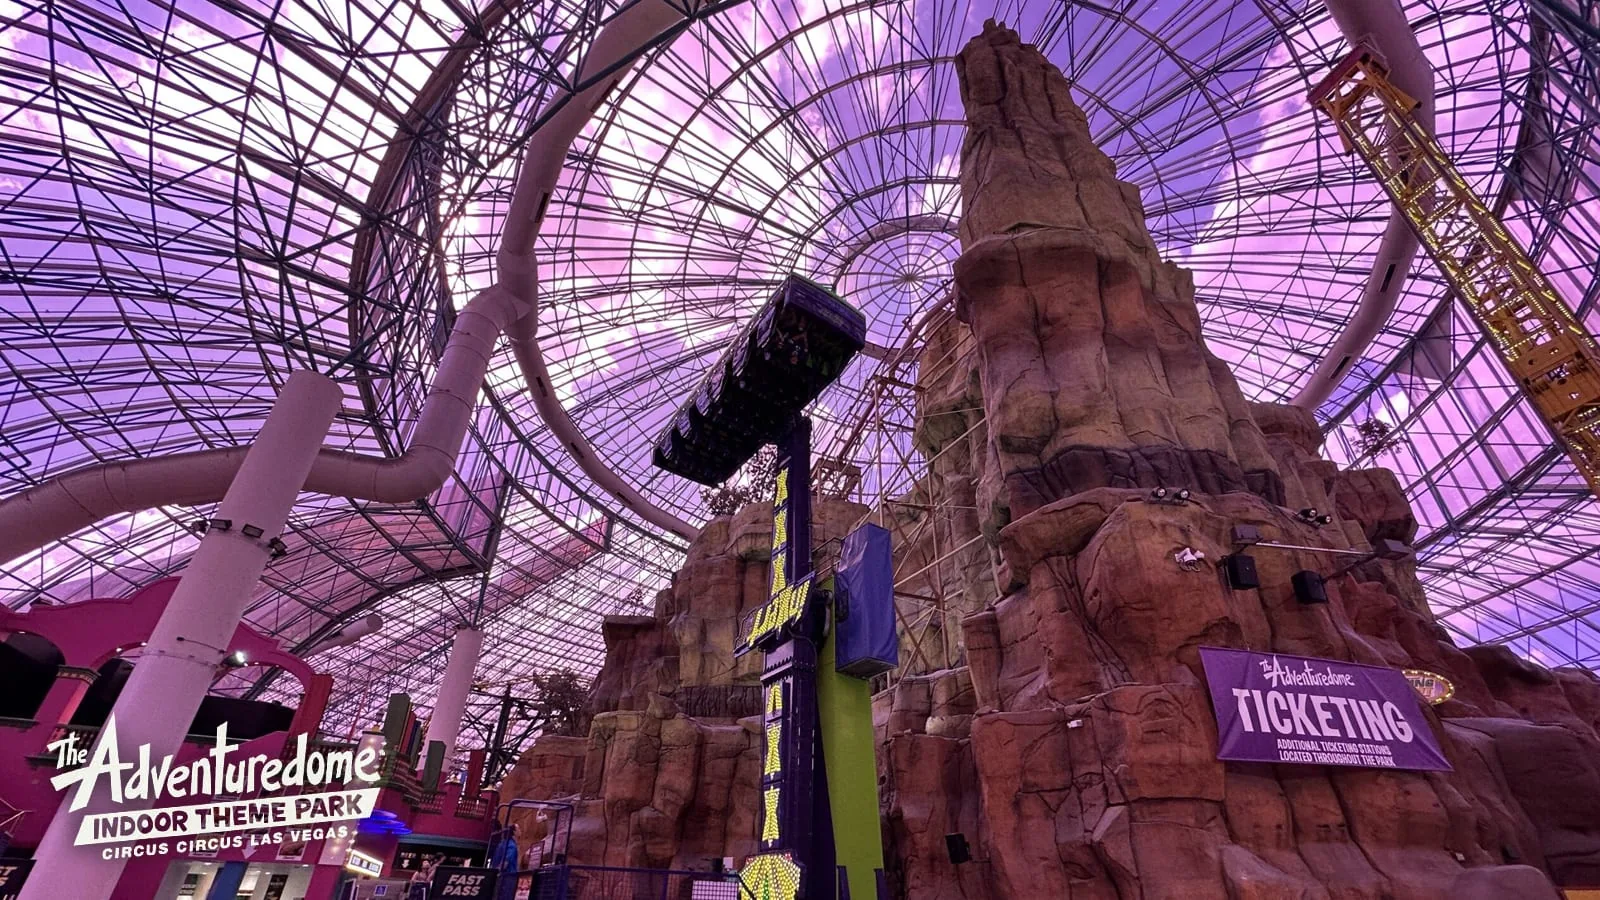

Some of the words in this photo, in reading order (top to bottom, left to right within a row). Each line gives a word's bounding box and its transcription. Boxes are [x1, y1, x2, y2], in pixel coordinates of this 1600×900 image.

[1259, 659, 1272, 672] The
[1263, 653, 1355, 688] Adventuredome
[1232, 687, 1414, 743] TICKETING
[1277, 738, 1321, 751] ADDITIONAL
[1320, 741, 1359, 754] TICKETING
[1357, 743, 1392, 756] STATIONS
[1279, 750, 1313, 762] LOCATED
[1312, 752, 1361, 765] THROUGHOUT
[1361, 754, 1377, 766] THE
[1374, 755, 1397, 767] PARK
[447, 874, 485, 885] FAST
[442, 885, 481, 896] PASS
